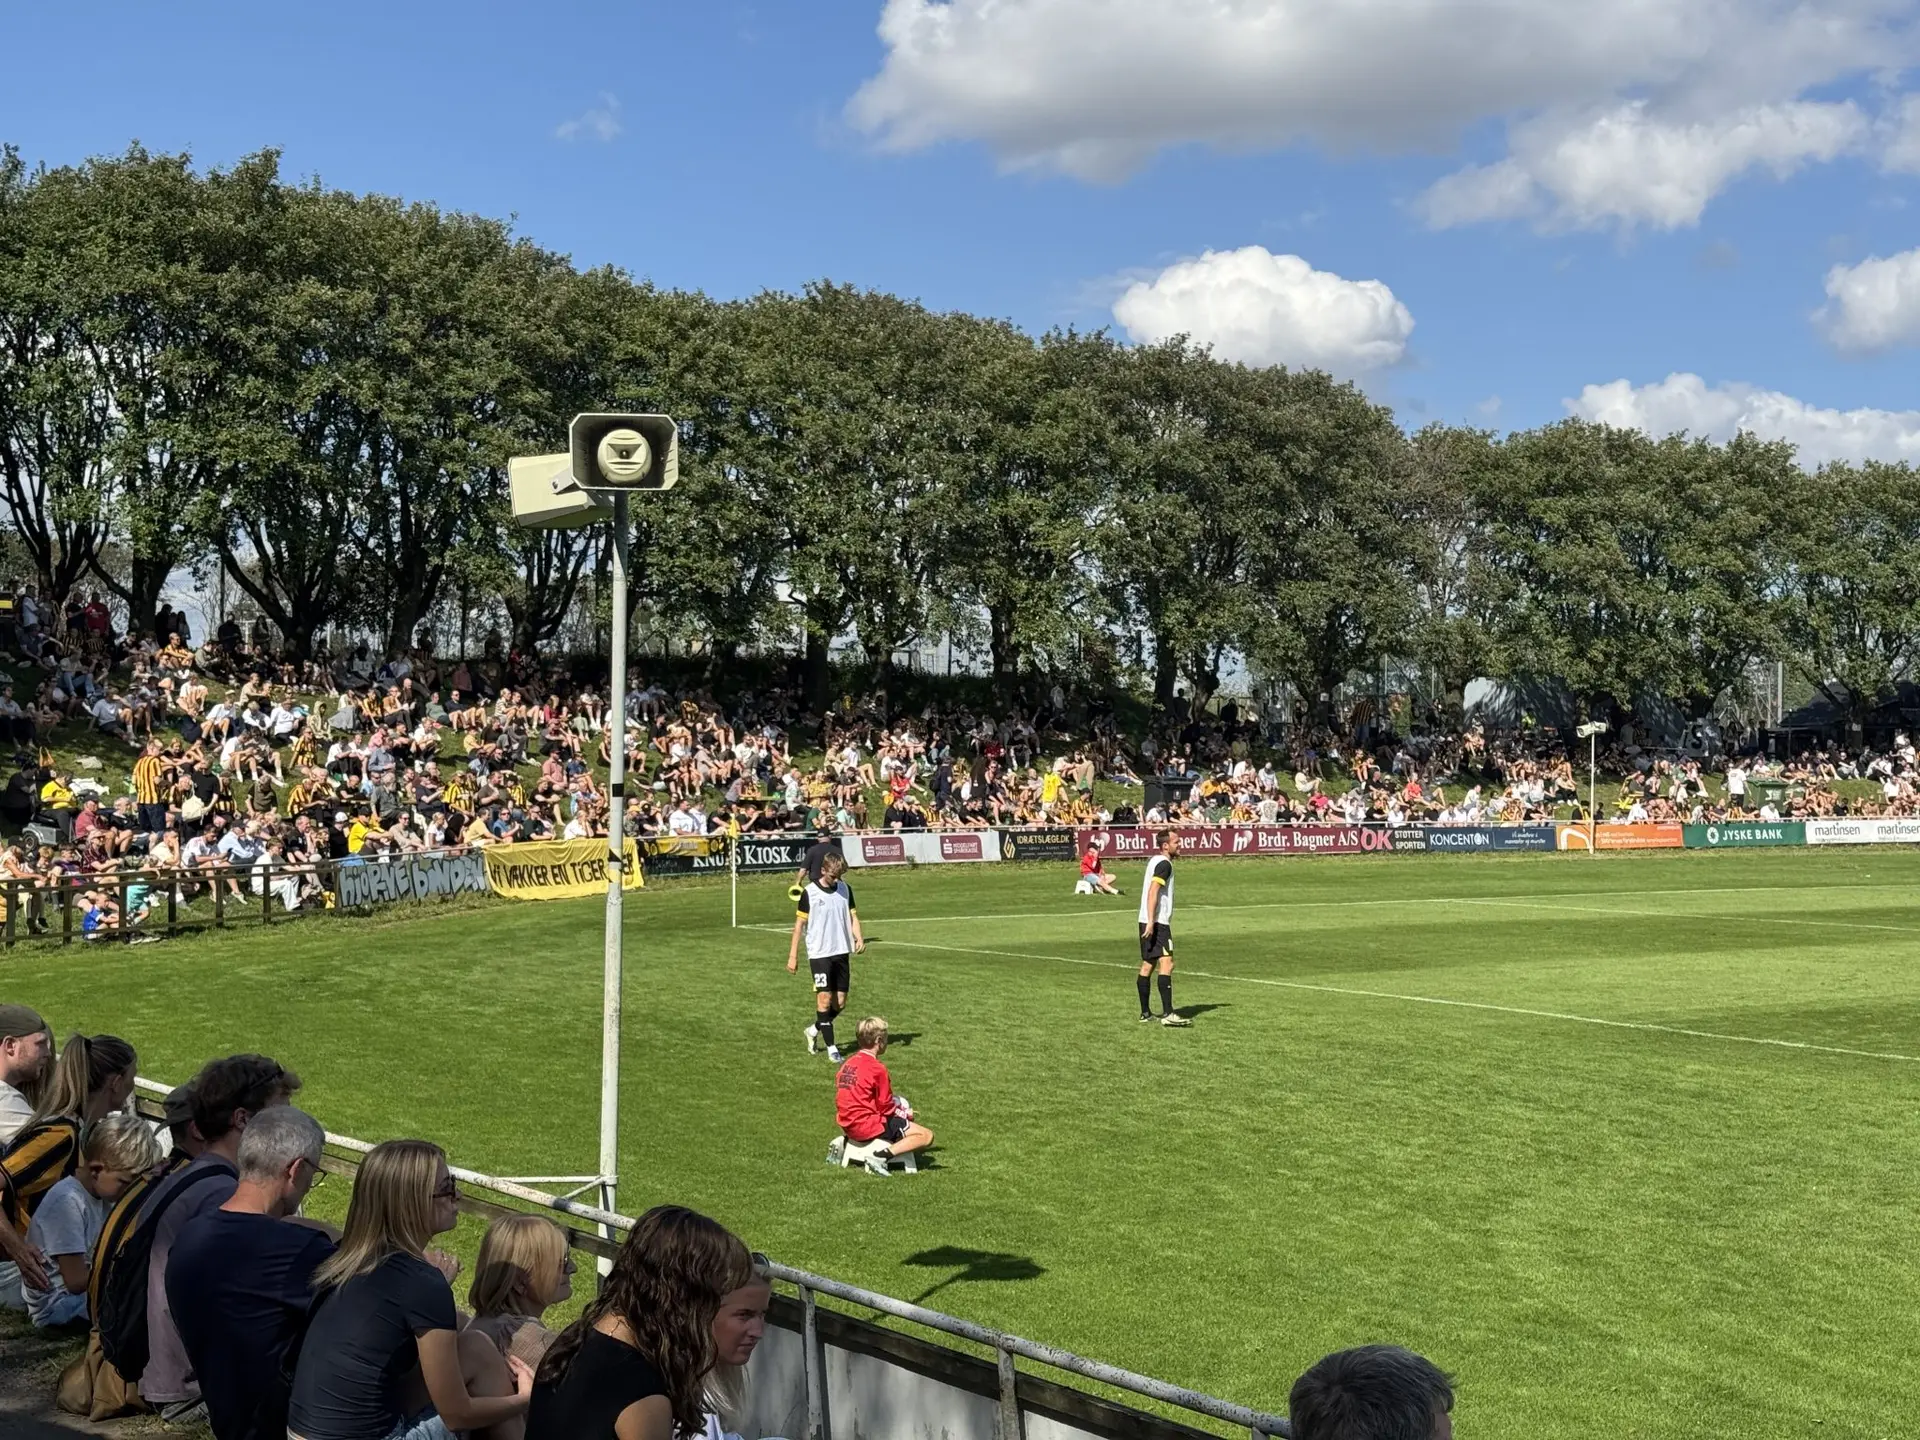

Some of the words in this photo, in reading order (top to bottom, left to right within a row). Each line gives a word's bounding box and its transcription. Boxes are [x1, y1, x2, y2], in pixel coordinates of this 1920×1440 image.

[1394, 830, 1424, 839] STØTTER
[1722, 829, 1752, 841] JYSKE
[1754, 828, 1783, 840] BANK
[1814, 822, 1861, 836] martinsen
[1115, 833, 1149, 851] Brdr.
[1199, 832, 1222, 849] A/S
[1258, 831, 1290, 848] Brdr.
[1293, 831, 1335, 851] Bagner
[1338, 831, 1359, 847] A/S
[1361, 827, 1394, 850] OK
[1395, 840, 1426, 850] SPORTEN
[1429, 832, 1490, 846] KONCENTON
[743, 845, 792, 866] KIOSK
[504, 862, 551, 889] VÆKKER
[550, 863, 571, 886] EN
[814, 973, 827, 987] 23
